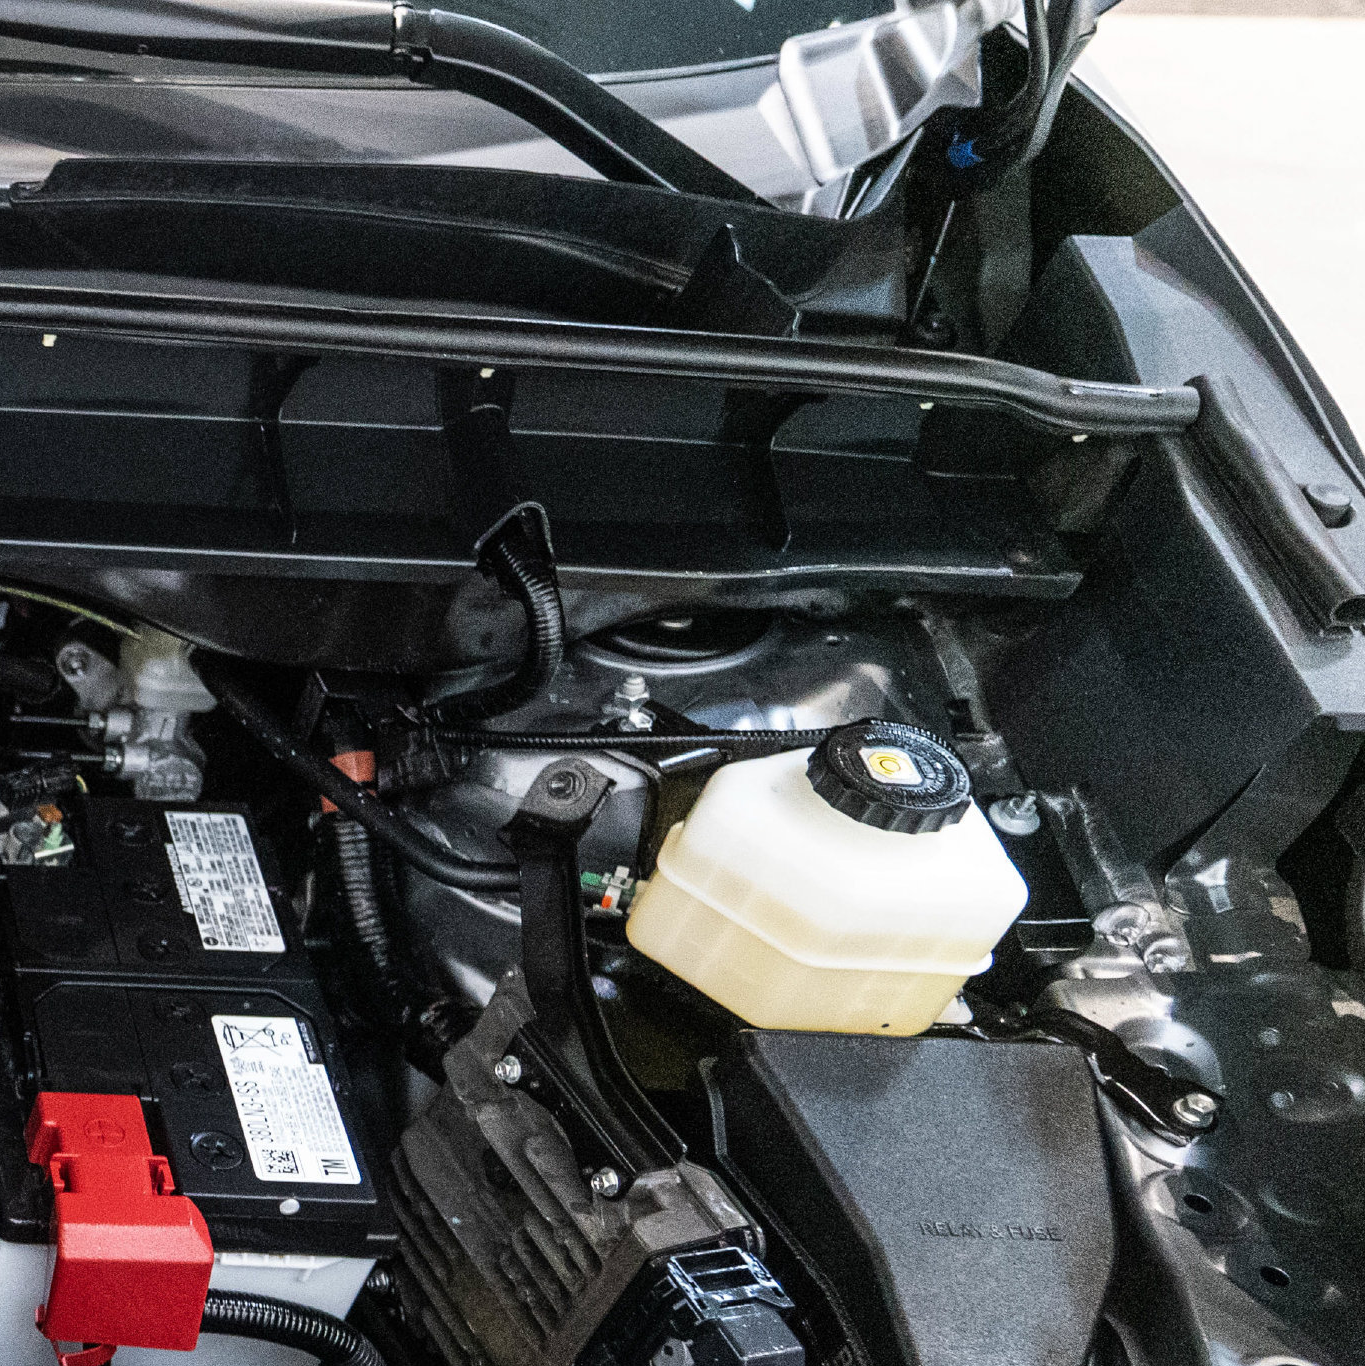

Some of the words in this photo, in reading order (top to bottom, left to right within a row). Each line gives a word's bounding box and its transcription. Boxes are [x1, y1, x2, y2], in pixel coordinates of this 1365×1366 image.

[322, 1157, 349, 1177] TM
[919, 1221, 983, 1239] RELAY
[989, 1222, 1004, 1239] &
[1005, 1223, 1065, 1243] FUSE
